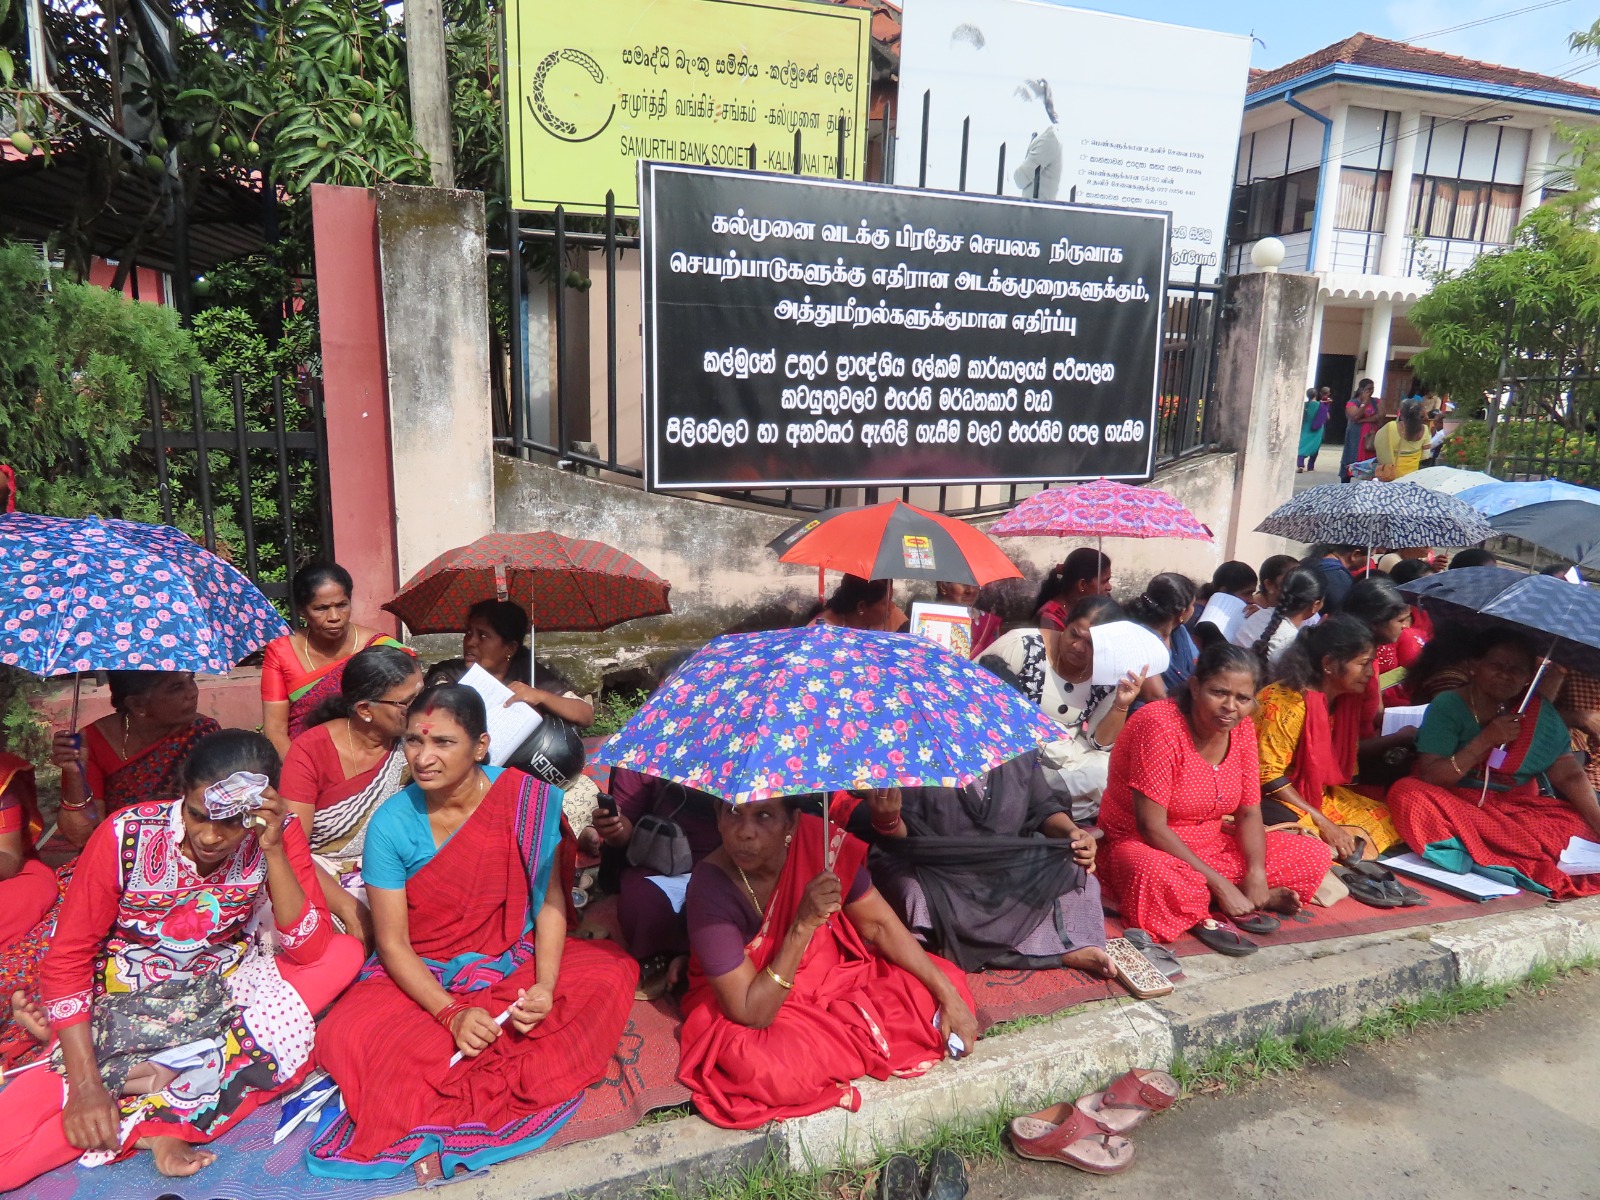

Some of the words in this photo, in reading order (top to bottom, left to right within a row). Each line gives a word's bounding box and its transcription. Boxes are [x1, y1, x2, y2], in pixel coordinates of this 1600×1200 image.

[676, 49, 710, 77] බැංකු
[716, 53, 758, 77] සමිතිය
[825, 68, 853, 93] දෙමළ
[621, 88, 667, 120] சமுர்த்தி
[676, 93, 714, 119] வங்கிச்
[722, 97, 756, 122] சங்கம்
[621, 135, 676, 160] SAMURTHI
[680, 141, 708, 163] BANK
[711, 144, 752, 168] SOCIET
[711, 208, 816, 242] கல்முனை
[821, 219, 889, 249] வடக்கு
[895, 224, 964, 255] பிரதேச
[970, 234, 1040, 258] செயலக
[1049, 238, 1123, 265] நிருவாக
[670, 250, 866, 287] செயற்பாடுகளுக்கு
[872, 262, 949, 290] எதிரான
[955, 268, 1149, 303] அடக்குமுறைகளுக்கும்,
[774, 295, 1008, 330] அத்துமீறல்களுக்குமான
[1012, 308, 1077, 336] எதிர்ப்பு
[704, 347, 776, 378] කල්මුනේ
[785, 350, 828, 380] උතුර
[781, 385, 877, 415] කටයුතුවලට
[884, 386, 932, 411] එරෙහි
[757, 422, 779, 444] හා
[786, 419, 853, 448] අනවසර
[967, 421, 1002, 446] වලට
[1008, 420, 1063, 443] එරෙහිව
[1068, 423, 1099, 446] පෙල
